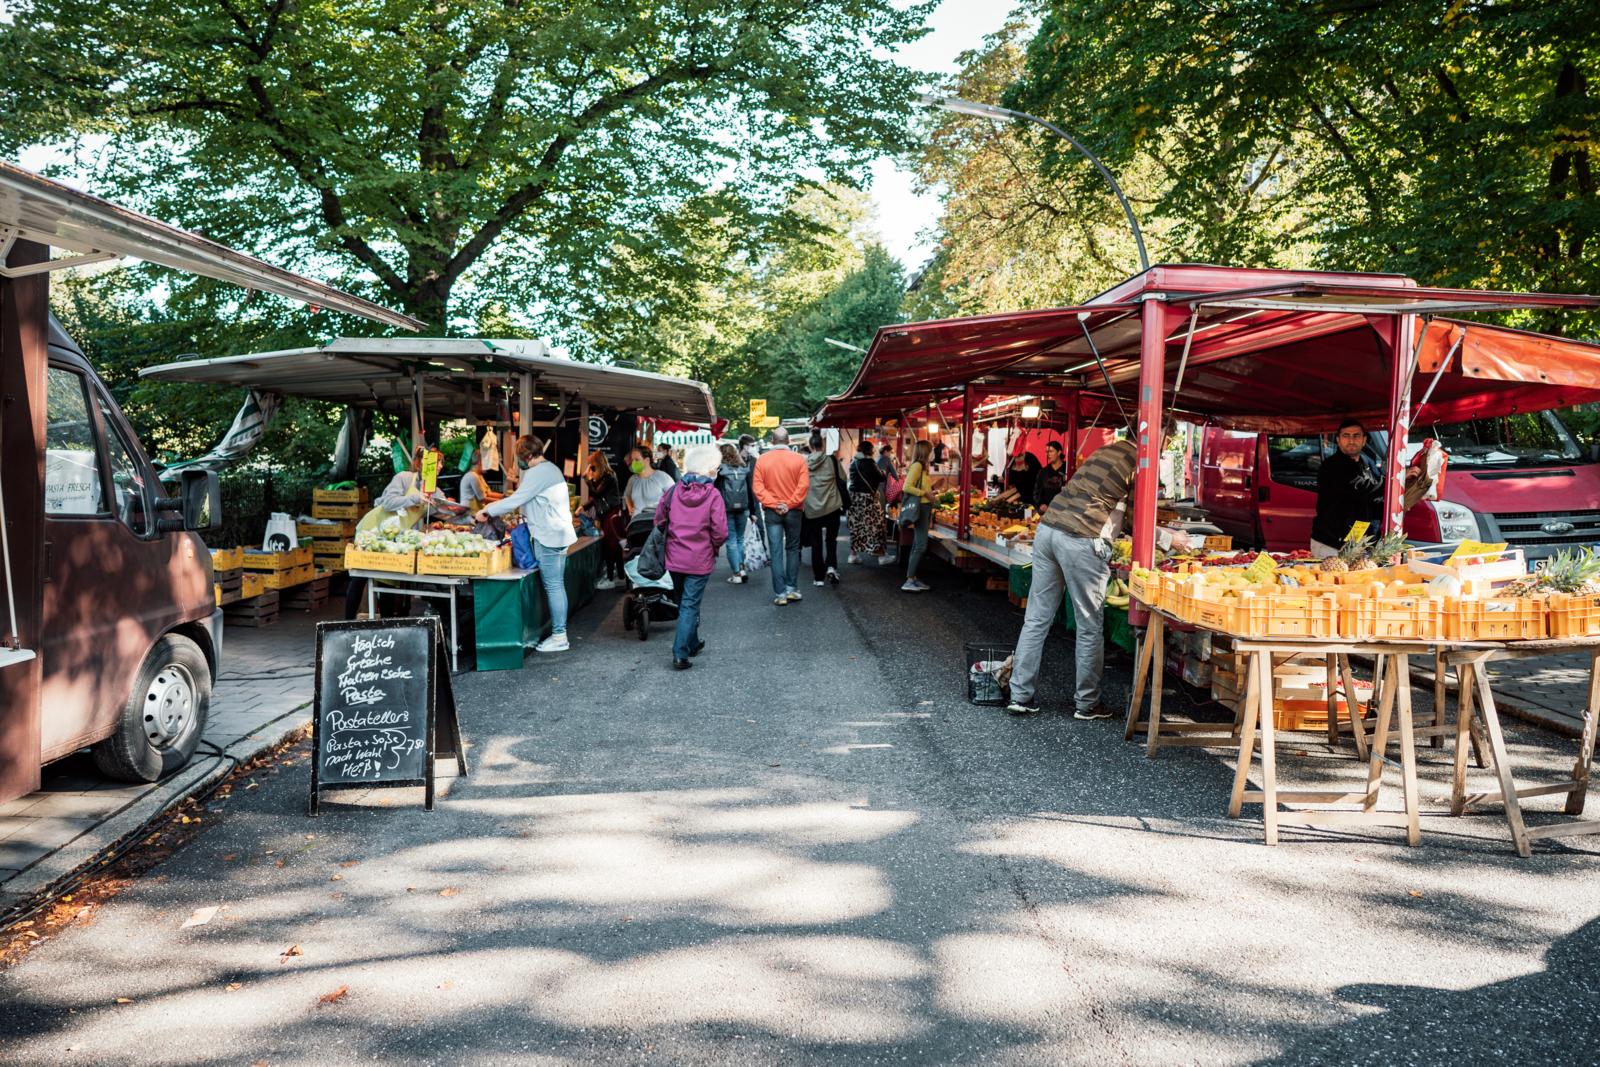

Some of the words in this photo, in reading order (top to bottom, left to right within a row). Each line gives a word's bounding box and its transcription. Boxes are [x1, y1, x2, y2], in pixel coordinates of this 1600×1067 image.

[68, 482, 91, 492] FRESCA
[351, 634, 396, 657] täglich
[345, 655, 392, 674] frische
[340, 686, 387, 703] Pasta
[326, 737, 362, 753] Pasta
[325, 750, 352, 767] nach
